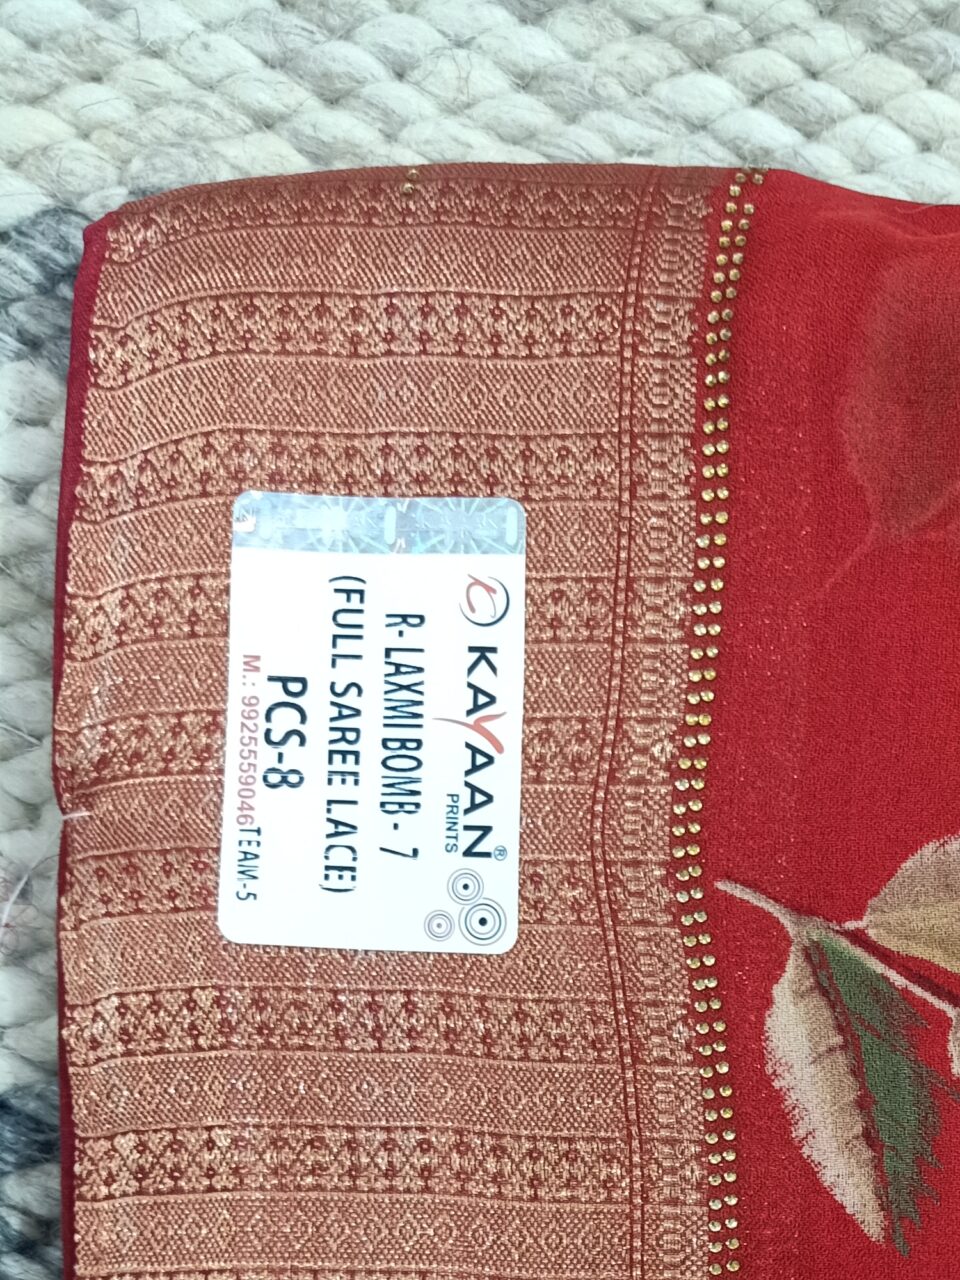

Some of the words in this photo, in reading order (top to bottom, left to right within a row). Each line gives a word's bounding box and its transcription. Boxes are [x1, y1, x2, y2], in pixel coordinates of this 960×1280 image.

[328, 575, 367, 669] (FULL
[263, 675, 308, 789] PCS-8
[327, 681, 363, 786] SAREE
[383, 648, 425, 728] LAXMI
[379, 738, 424, 815] BOMB
[433, 645, 505, 859] KAYAAN
[318, 800, 359, 893] LACE)
[379, 847, 420, 860] 7
[445, 793, 460, 853] PRINTS
